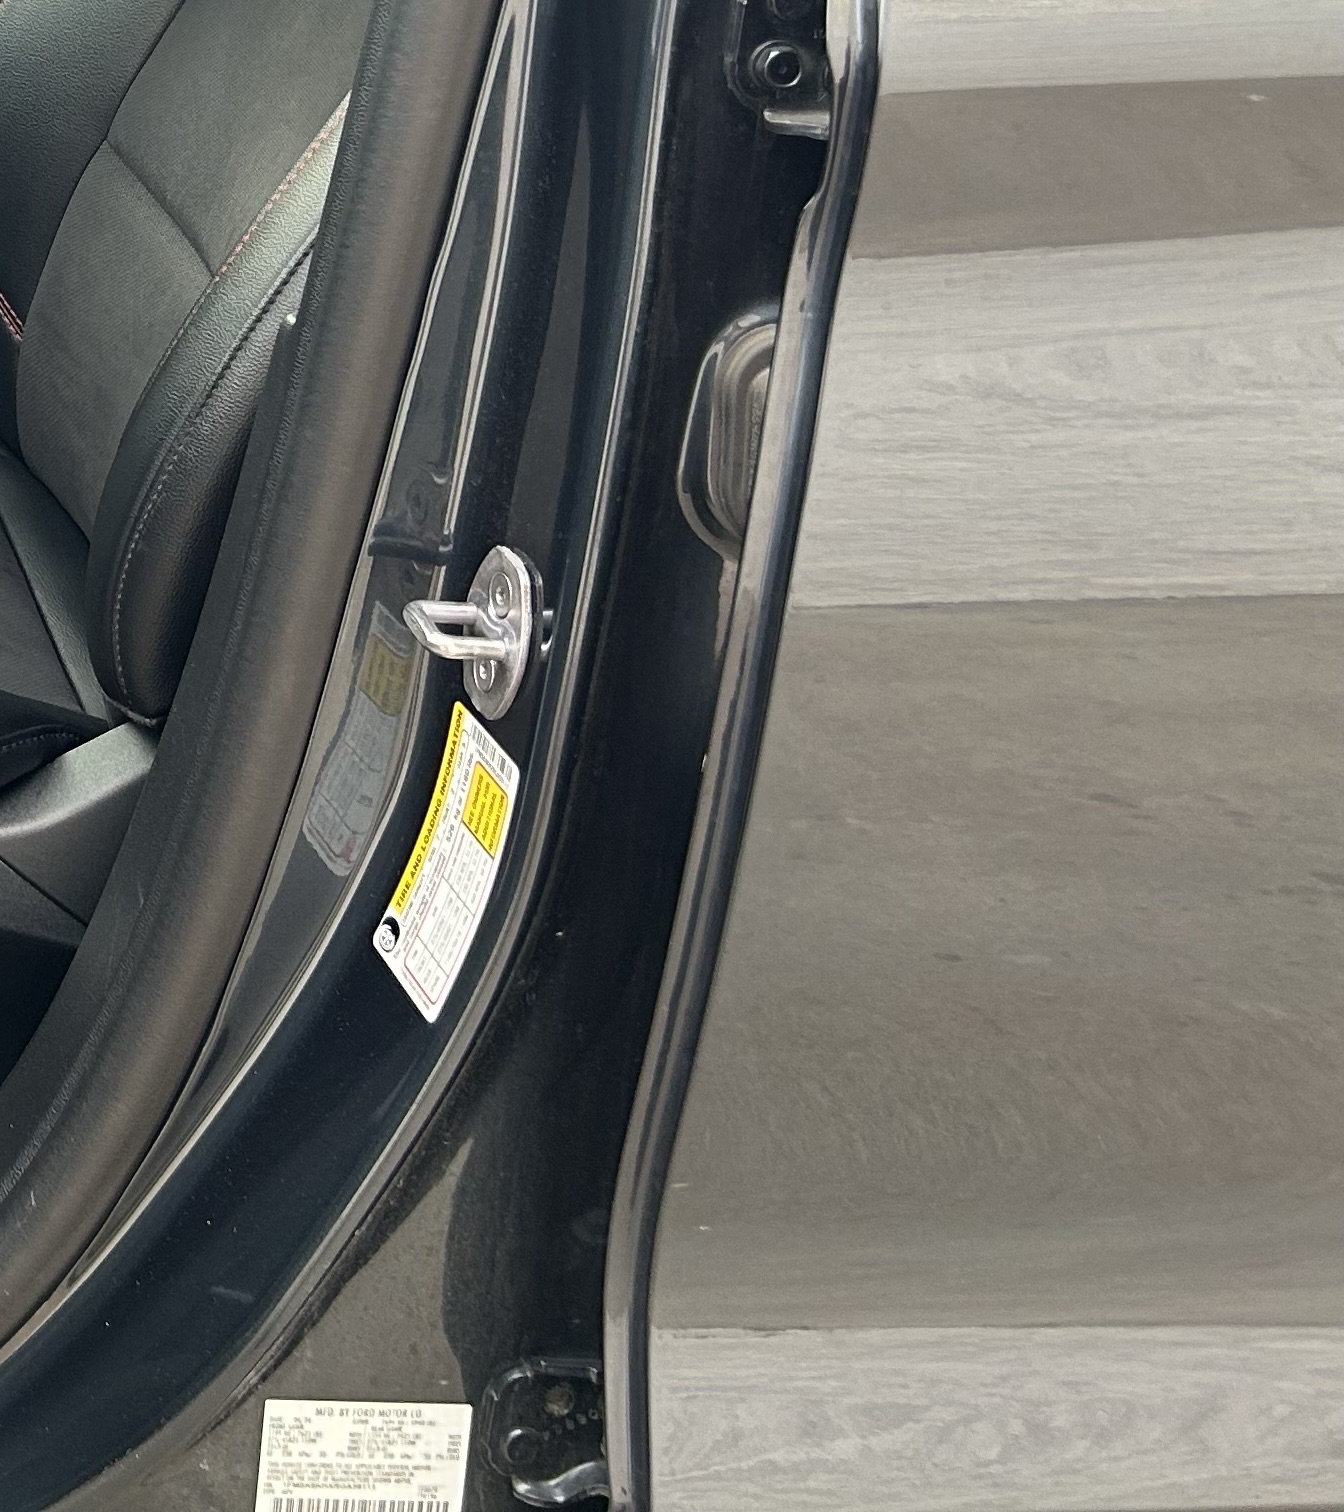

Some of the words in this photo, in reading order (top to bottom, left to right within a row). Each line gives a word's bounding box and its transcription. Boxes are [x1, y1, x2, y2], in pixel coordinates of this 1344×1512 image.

[395, 881, 412, 909] TIRE
[411, 853, 423, 877] AND
[422, 799, 443, 851] LOADING
[440, 710, 464, 796] INFORMATION
[352, 1408, 375, 1418] FORD
[378, 1409, 409, 1418] MOTOR
